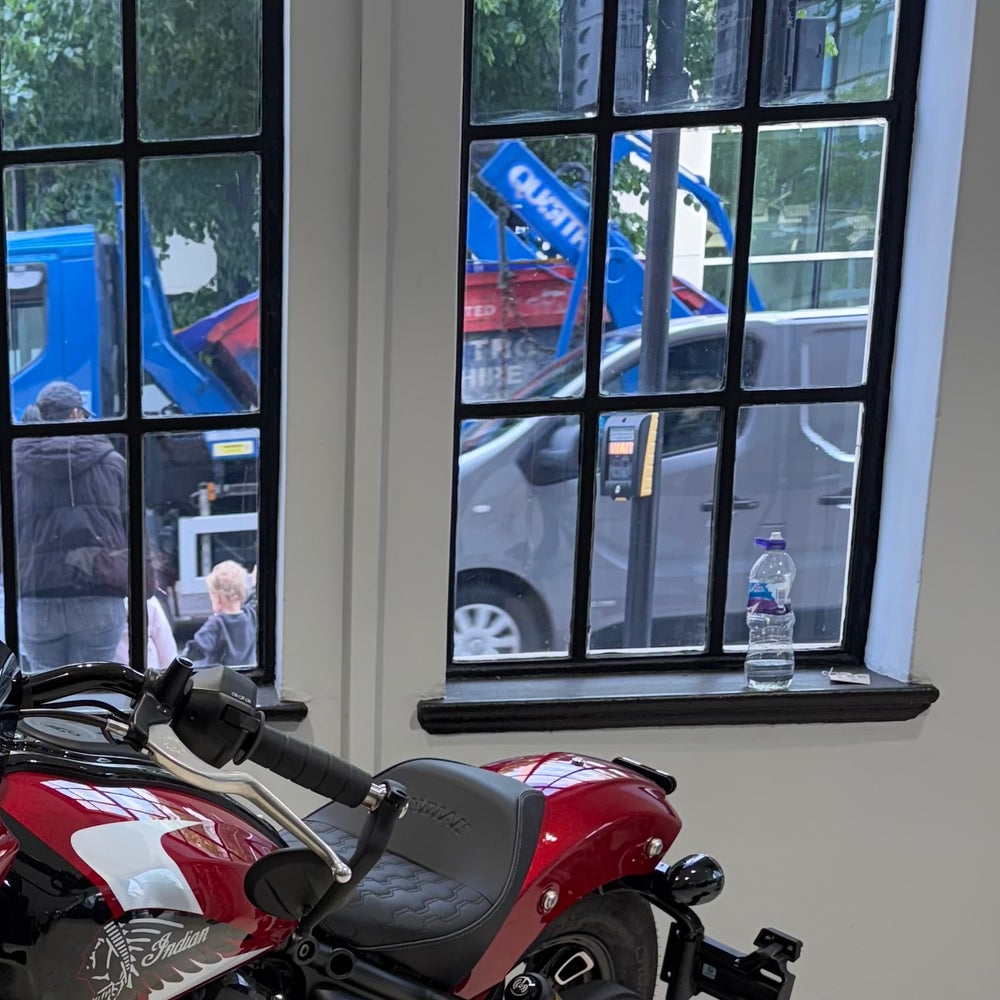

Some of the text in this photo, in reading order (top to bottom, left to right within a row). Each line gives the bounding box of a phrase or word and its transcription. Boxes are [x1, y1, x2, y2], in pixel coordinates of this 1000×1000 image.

[507, 164, 587, 253] QUATTR
[407, 796, 473, 836] NDIAN
[141, 926, 210, 967] Indian
